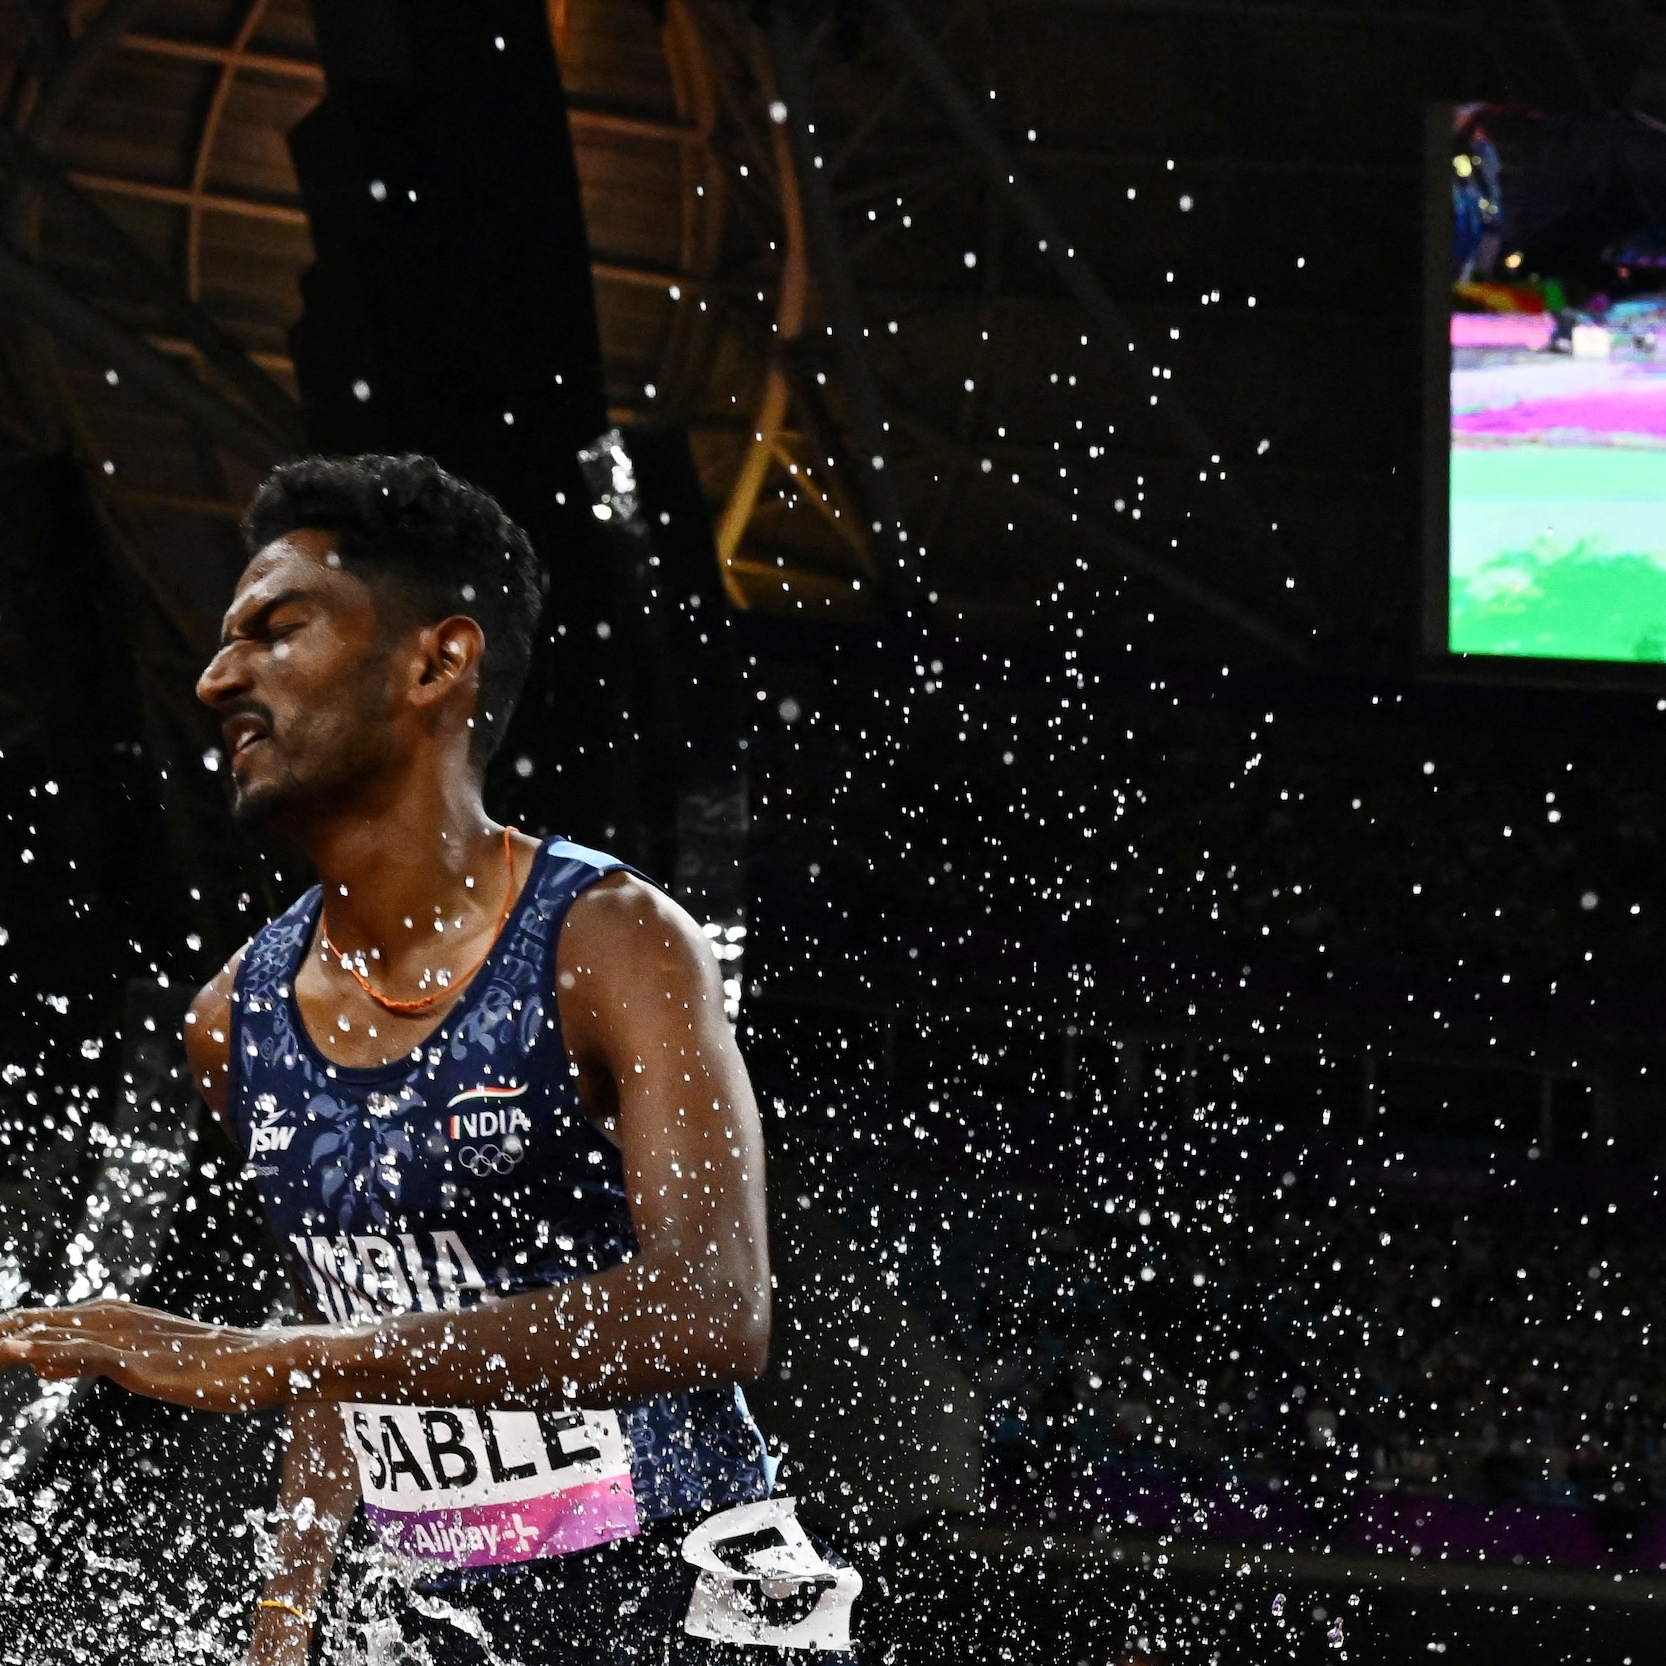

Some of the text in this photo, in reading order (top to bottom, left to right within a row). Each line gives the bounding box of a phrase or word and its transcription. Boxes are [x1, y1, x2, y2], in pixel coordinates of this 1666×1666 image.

[248, 1125, 297, 1160] JSW
[449, 1107, 531, 1141] INDIA
[290, 1230, 499, 1324] INDIA
[354, 1406, 602, 1492] SABLE
